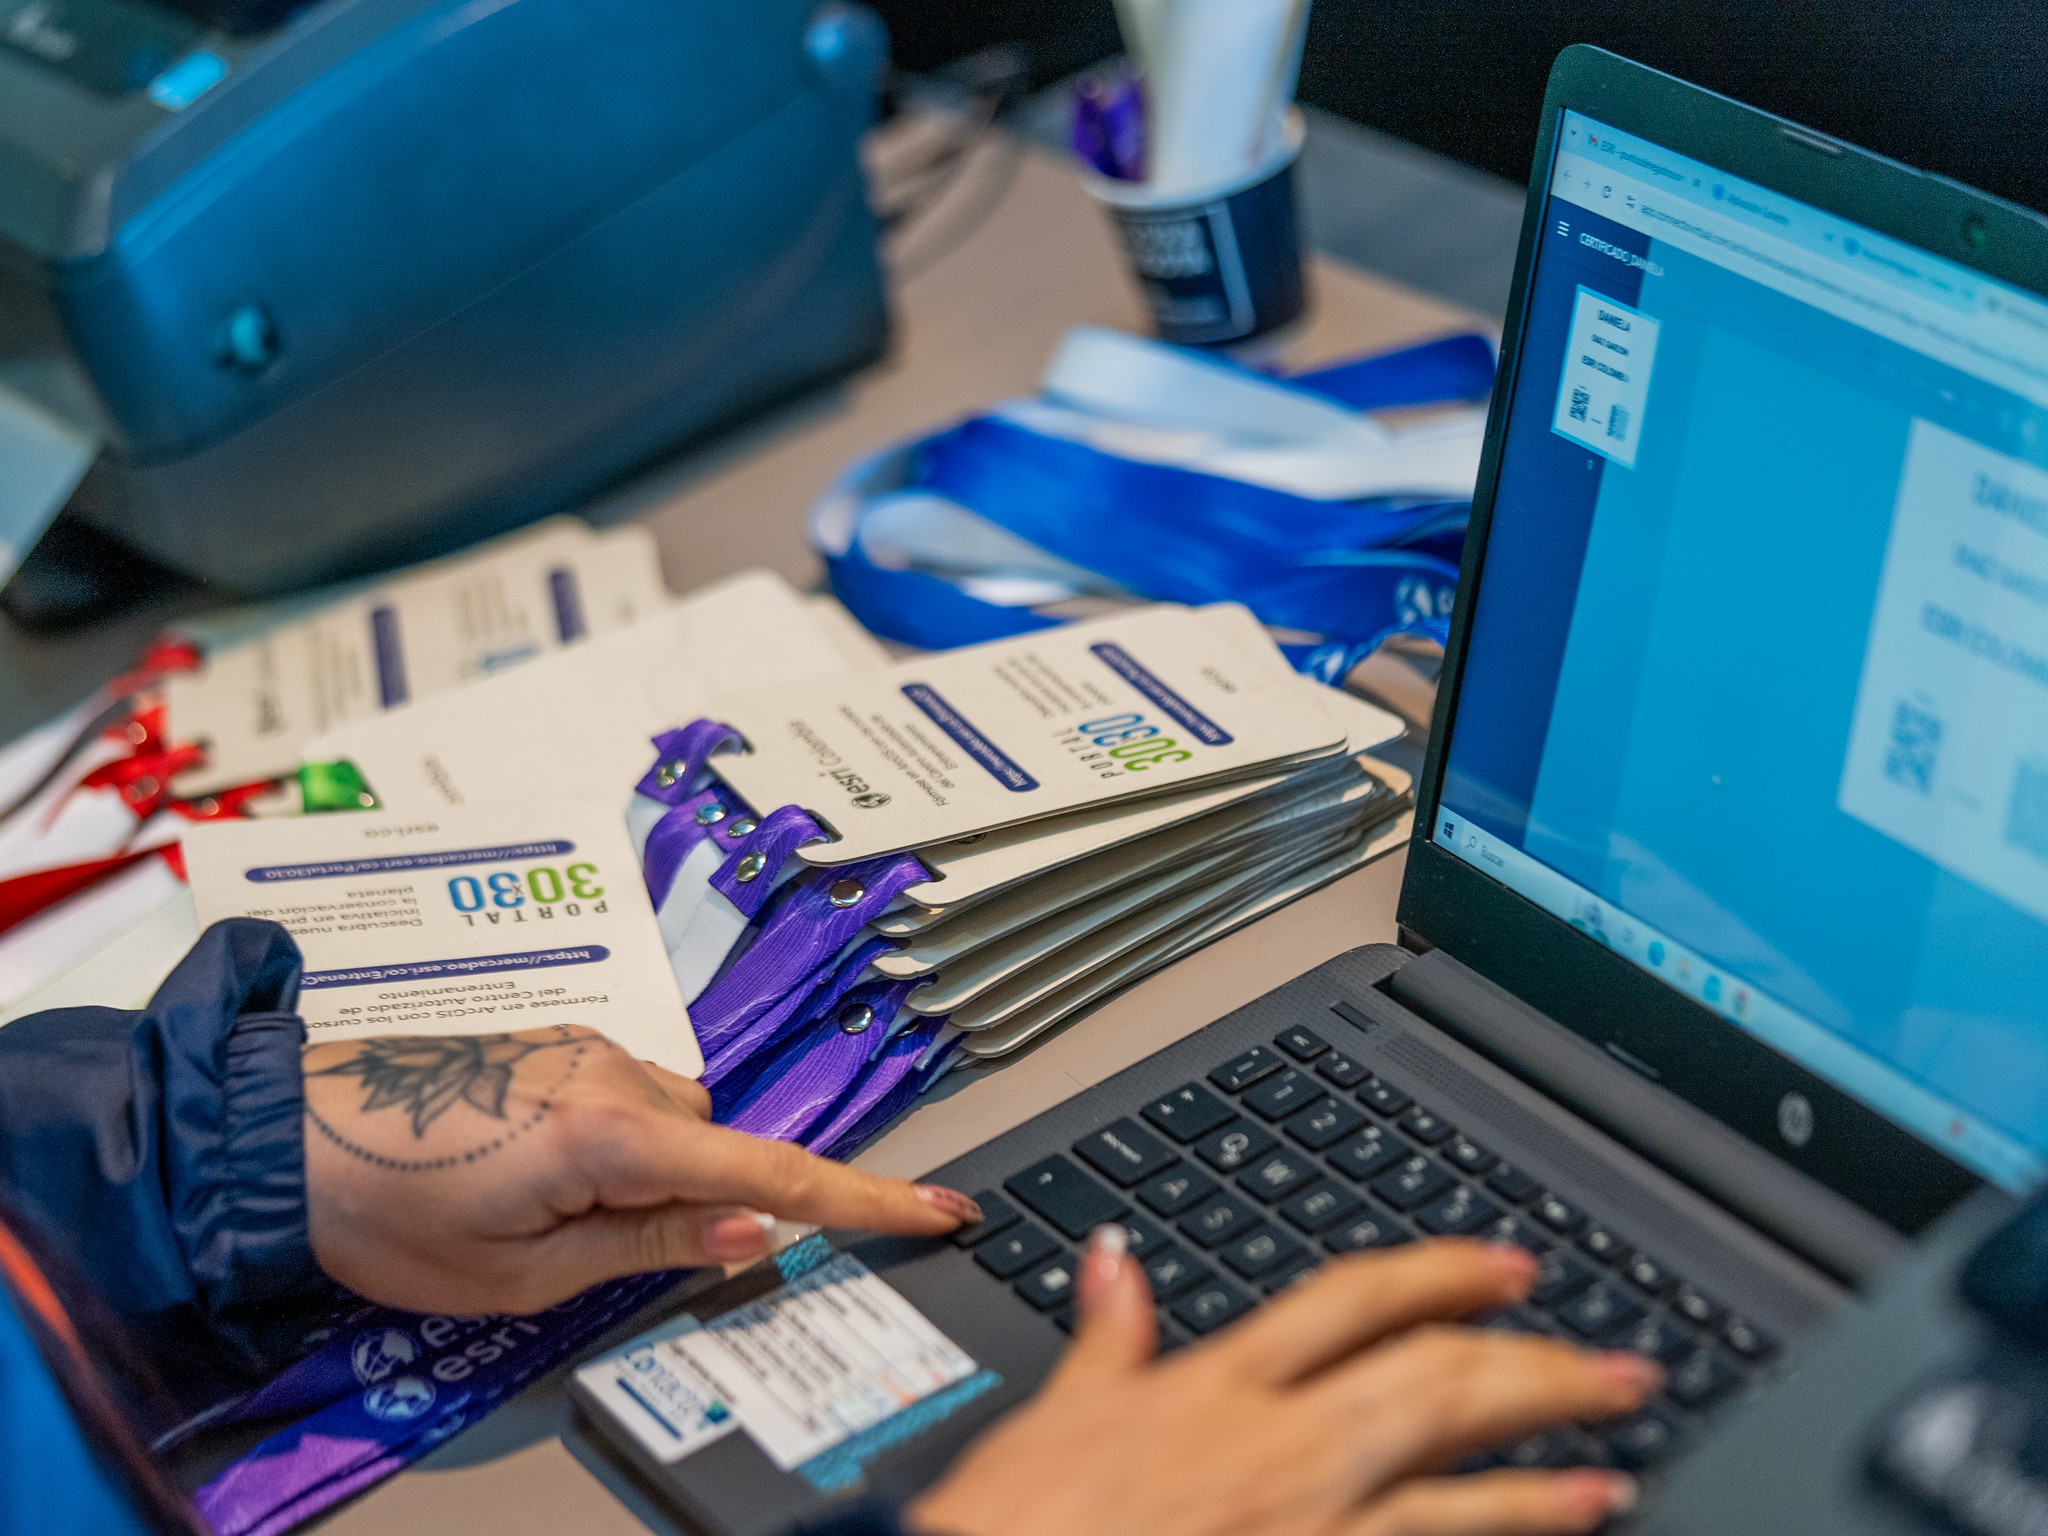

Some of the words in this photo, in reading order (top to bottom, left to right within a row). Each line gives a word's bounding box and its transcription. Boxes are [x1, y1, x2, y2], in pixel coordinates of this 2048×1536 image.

[1597, 309, 1631, 333] DANIELA
[1053, 726, 1126, 780] PORTAL
[819, 768, 870, 794] esri
[346, 886, 414, 898] planeta
[402, 897, 417, 905] la
[313, 915, 335, 923] en
[341, 908, 420, 921] iniciativa
[460, 900, 608, 927] PORTAL
[289, 926, 332, 936] nues
[338, 918, 423, 932] Descubra
[379, 981, 516, 1000] Entrenamiento
[472, 990, 533, 1003] Centro
[538, 987, 566, 997] del
[367, 996, 466, 1013] Autorizado
[502, 1003, 525, 1011] en
[530, 994, 609, 1009] Fórmese
[339, 1006, 362, 1015] de
[398, 1012, 431, 1021] con
[435, 1005, 497, 1019] ArcGIS
[366, 1016, 392, 1024] los
